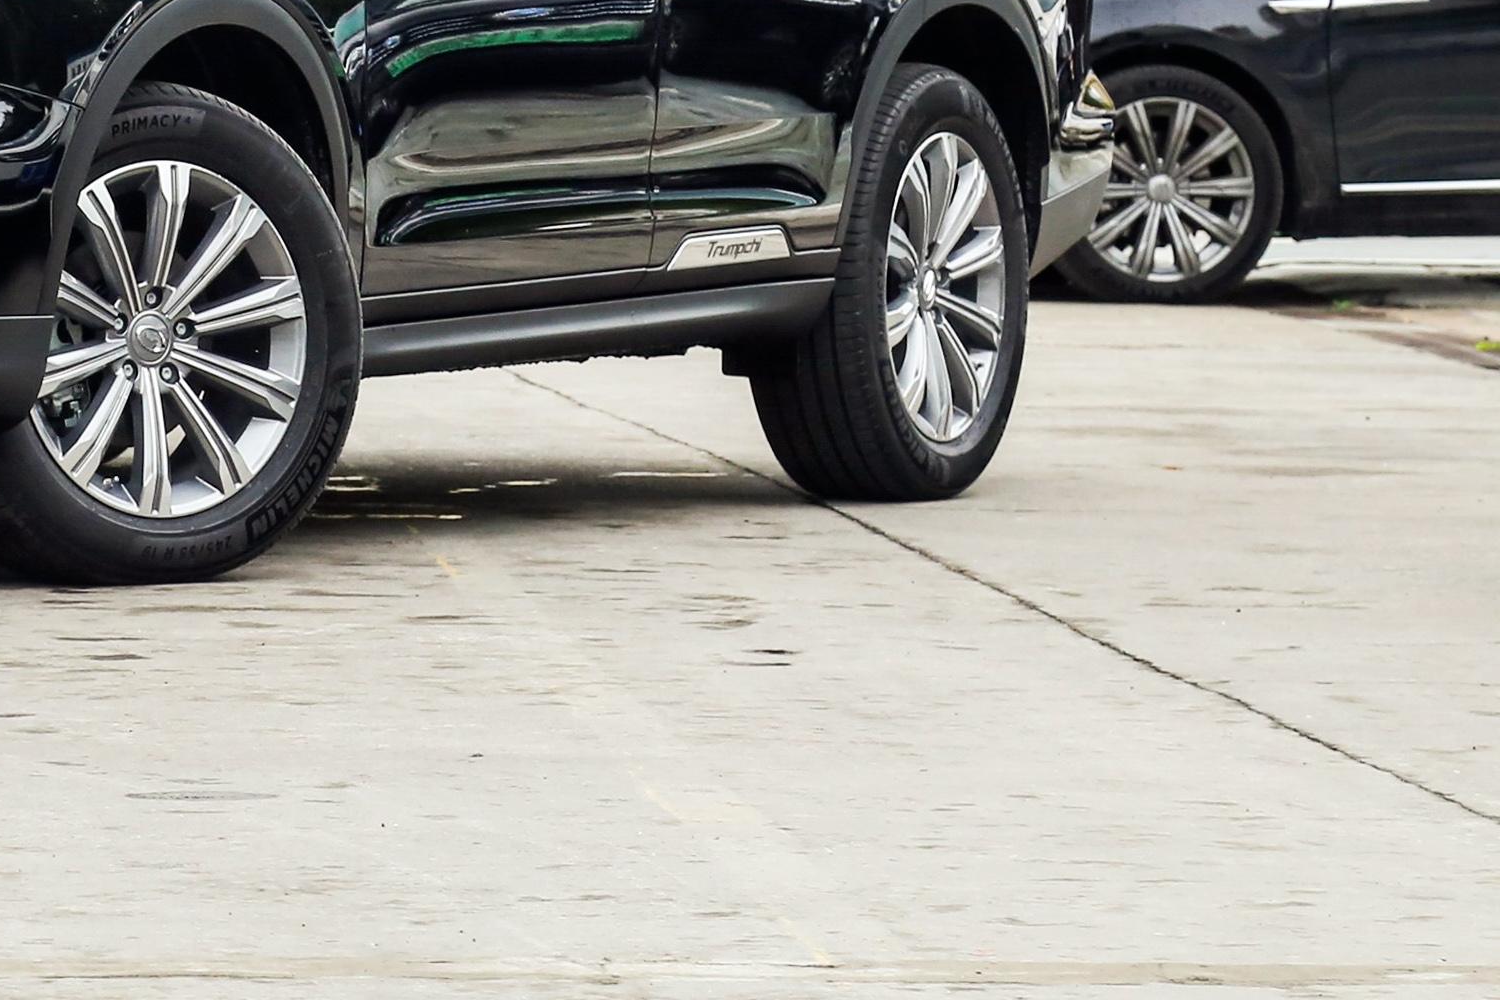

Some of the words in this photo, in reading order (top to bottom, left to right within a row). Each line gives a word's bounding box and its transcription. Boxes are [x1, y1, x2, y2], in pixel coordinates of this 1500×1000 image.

[111, 114, 181, 137] PRIMACY
[707, 238, 763, 259] Trumpchi
[251, 411, 342, 540] MICHELIN
